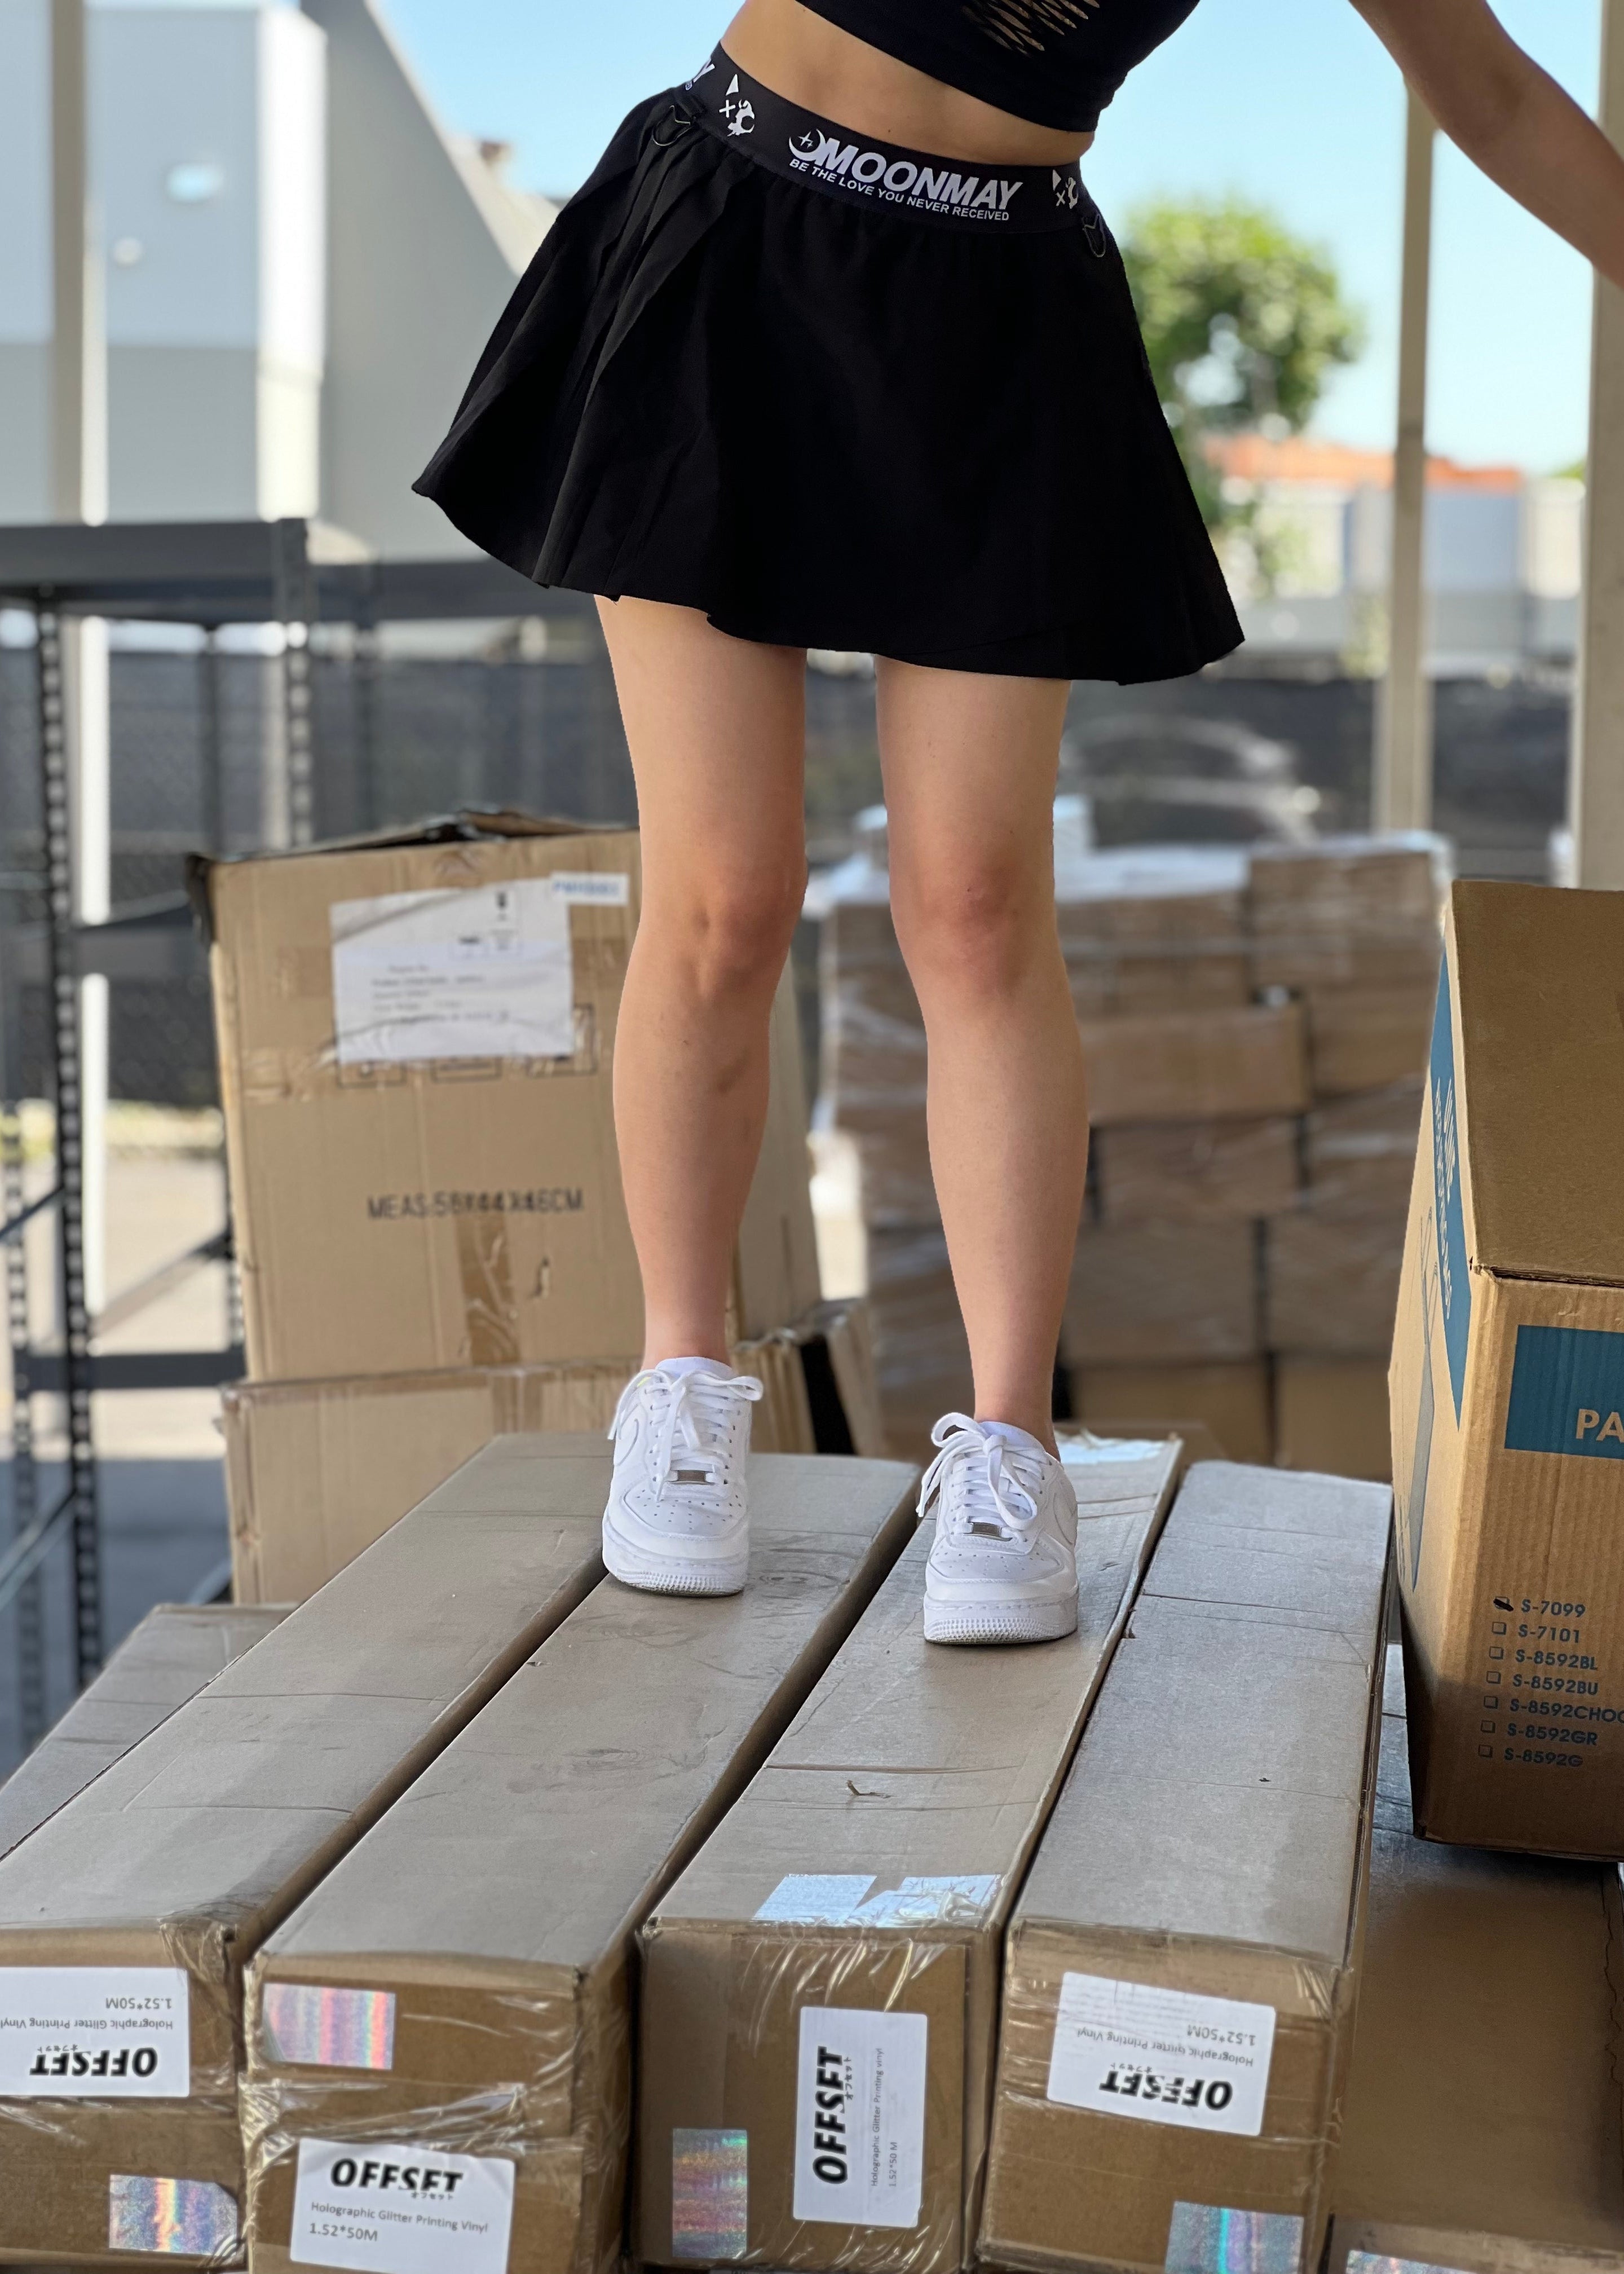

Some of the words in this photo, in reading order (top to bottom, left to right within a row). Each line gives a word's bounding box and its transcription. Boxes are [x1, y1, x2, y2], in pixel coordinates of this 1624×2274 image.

[815, 137, 1023, 210] MOONMAY
[789, 158, 808, 172] BE
[813, 166, 836, 182] THE
[839, 177, 875, 195] LOVE
[878, 188, 904, 203] YOU
[907, 196, 950, 213] NEVER
[952, 206, 1009, 221] RECEIVED
[1576, 1408, 1624, 1443] PA
[1521, 1598, 1586, 1618] S-7099
[1518, 1624, 1580, 1643] S-7101
[1515, 1649, 1598, 1671] S-8592BL
[1512, 1673, 1599, 1695] S-8592BU
[1507, 1722, 1598, 1746] S-8592GR
[1504, 1747, 1583, 1768] S-8592G
[0, 2017, 27, 2029] Vinyl
[29, 2017, 70, 2029] Printing
[74, 2020, 107, 2029] Glitter
[111, 2017, 173, 2030] Holographic
[1107, 2031, 1149, 2050] Printing
[29, 2047, 158, 2077] OFFSET
[876, 2048, 885, 2068] vinyl
[1189, 2047, 1254, 2067] Holographic
[873, 2070, 884, 2104] Printing
[1099, 2070, 1233, 2111] OFFSET
[812, 2045, 848, 2184] OFFSET
[872, 2106, 881, 2133] Glitter
[890, 2141, 898, 2150] M
[871, 2135, 881, 2187] Holographic
[330, 2158, 464, 2192] OFFSET
[311, 2201, 376, 2219] Holographic
[378, 2210, 412, 2223] Glitter
[416, 2215, 457, 2231] Printing
[461, 2220, 488, 2234] Vinyl
